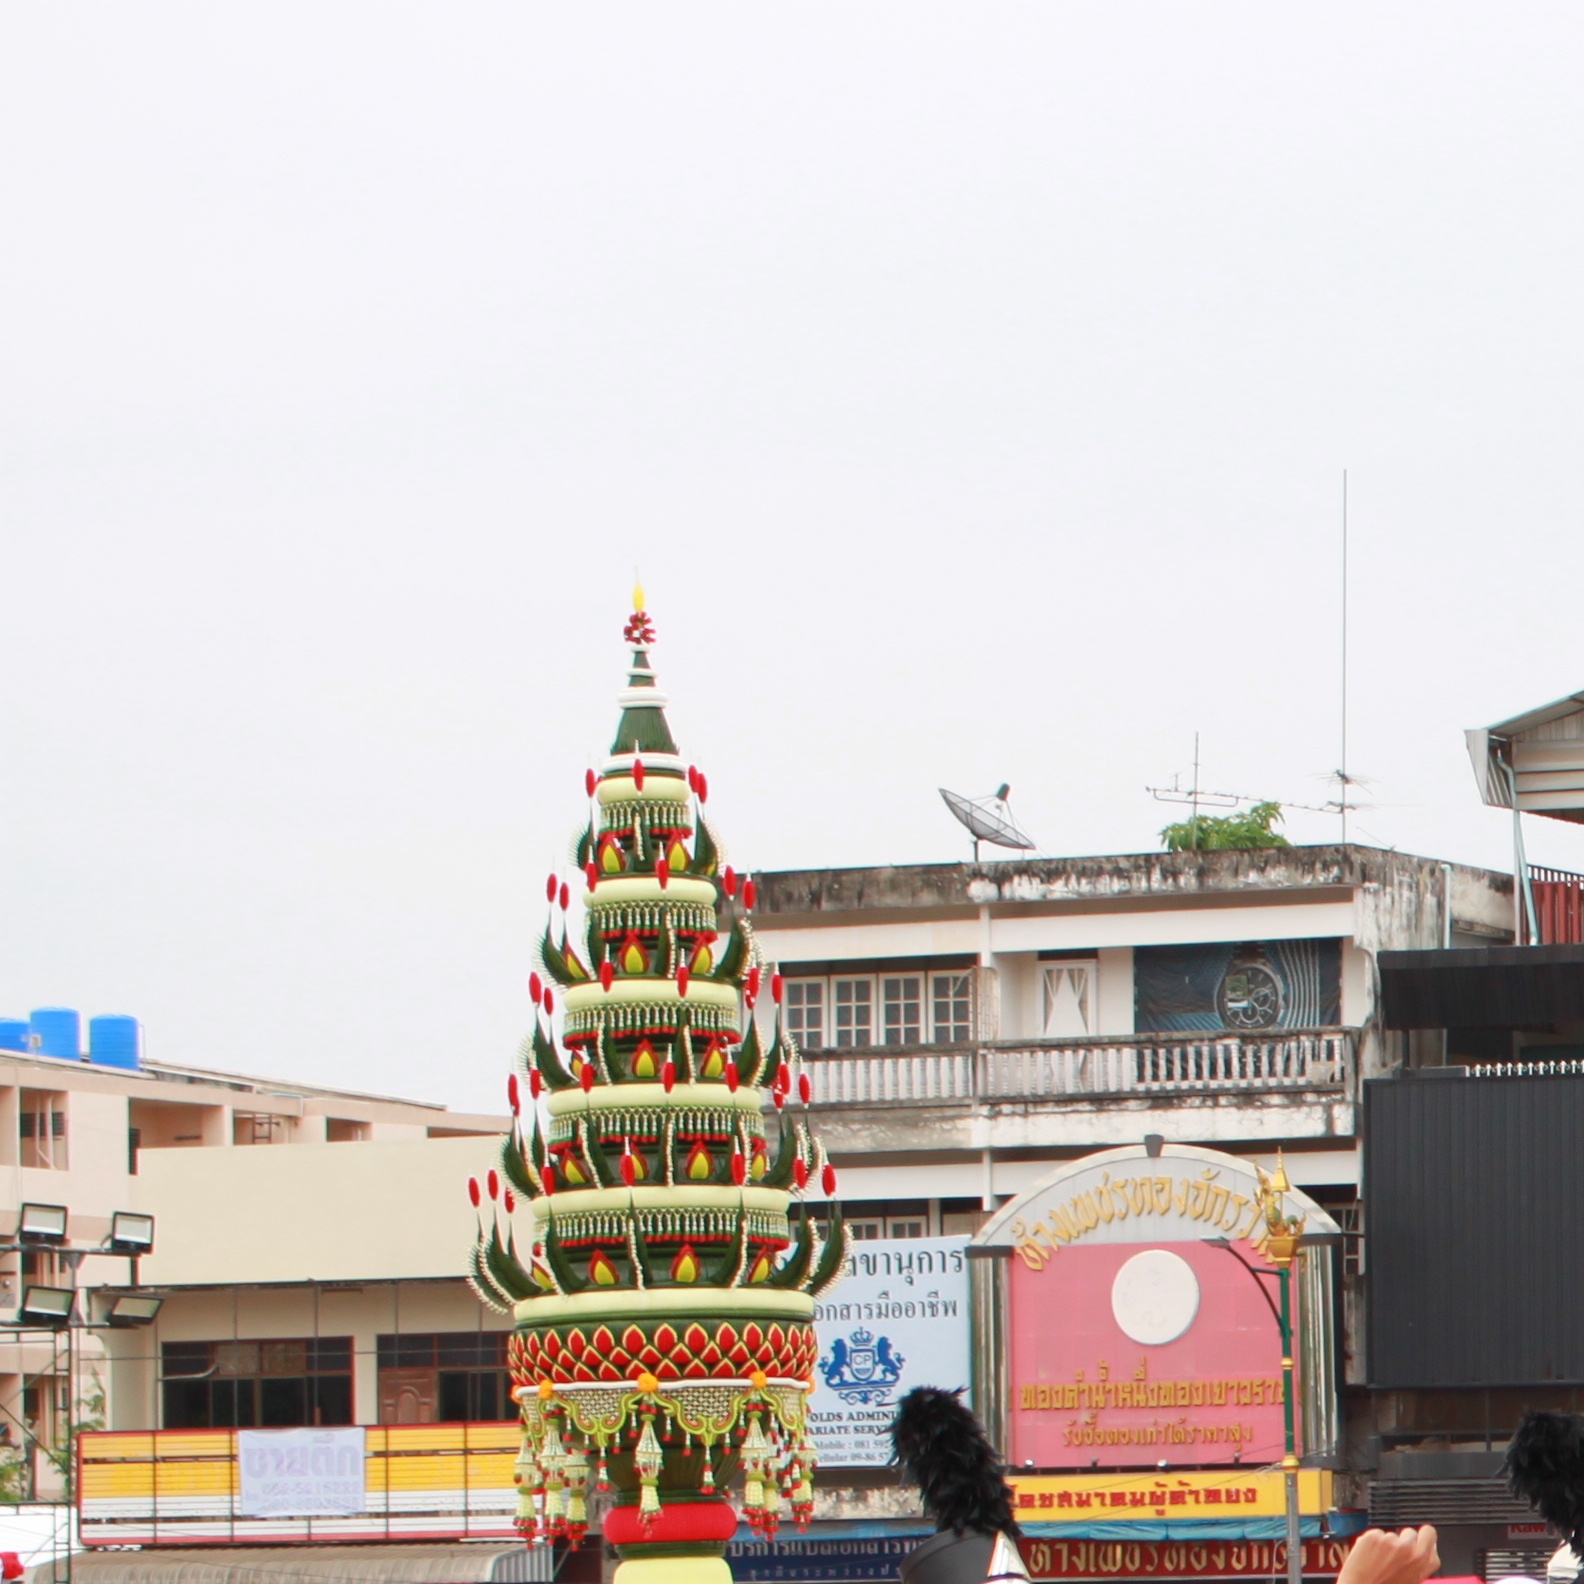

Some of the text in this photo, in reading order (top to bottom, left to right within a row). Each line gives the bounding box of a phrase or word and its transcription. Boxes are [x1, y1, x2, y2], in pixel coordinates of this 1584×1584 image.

[841, 1249, 964, 1286] ลขานุการ
[814, 1290, 958, 1321] อกสารมืออาชีพ
[853, 1354, 872, 1366] CP
[809, 1412, 843, 1423] OLDS
[808, 1425, 850, 1435] ARIATE
